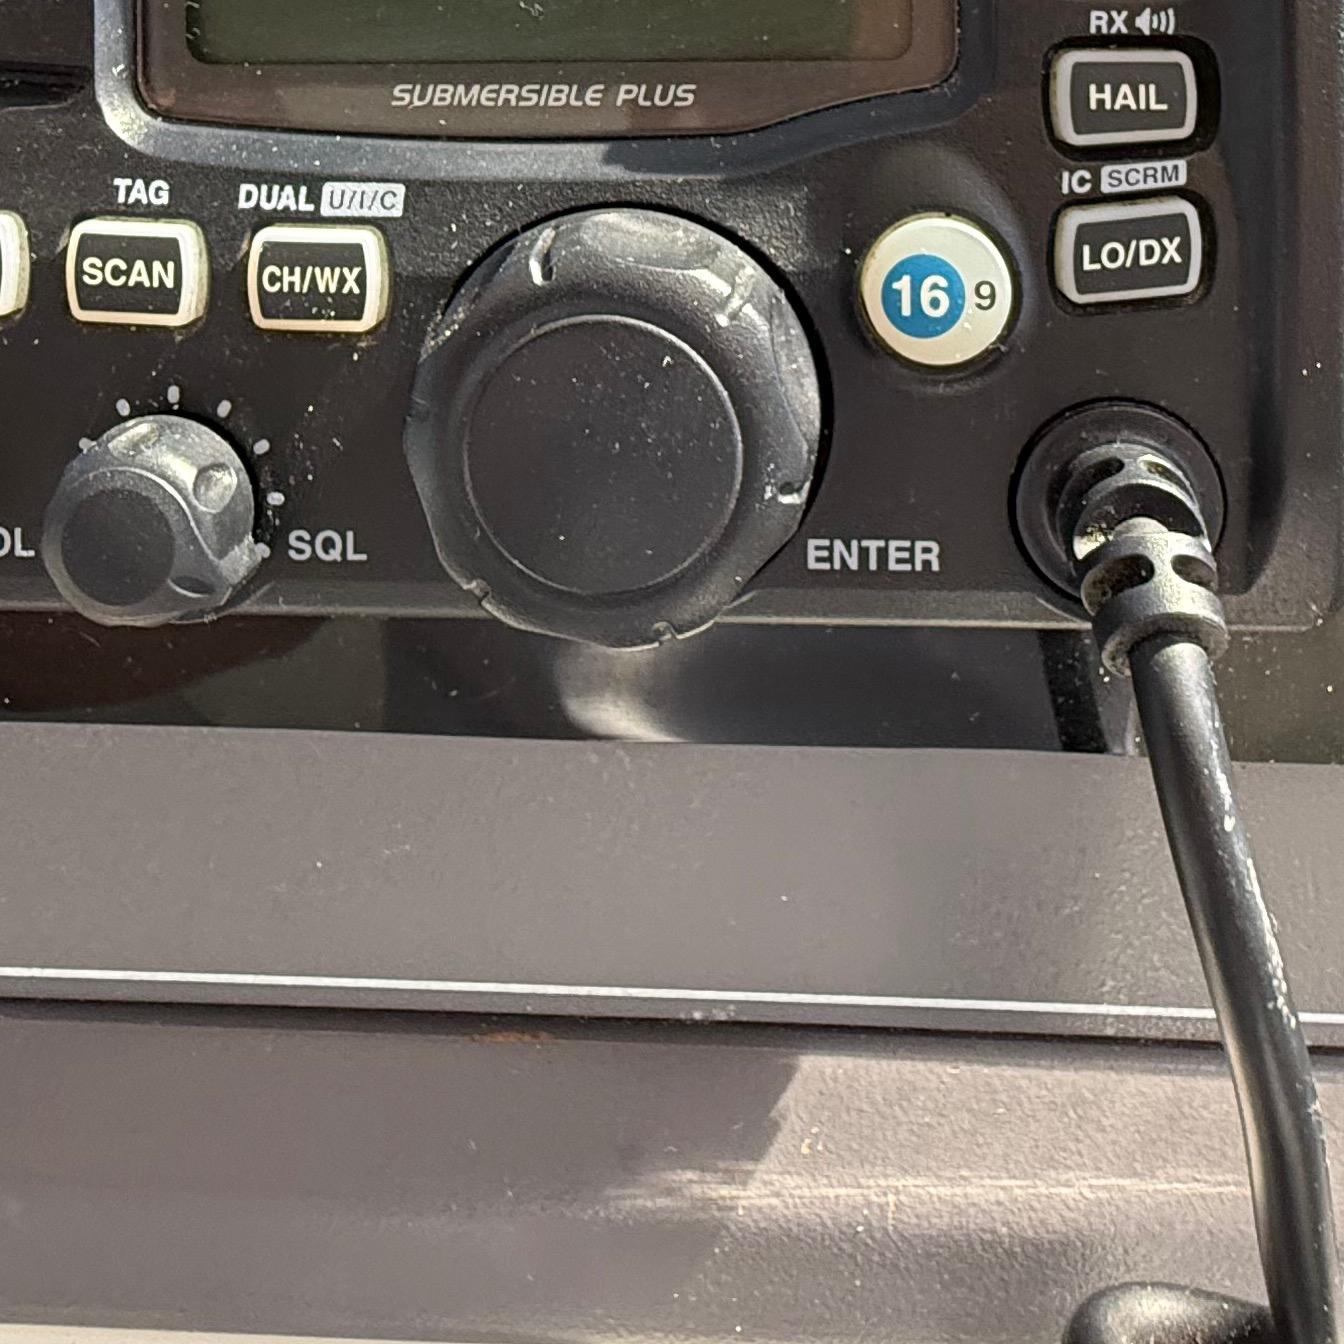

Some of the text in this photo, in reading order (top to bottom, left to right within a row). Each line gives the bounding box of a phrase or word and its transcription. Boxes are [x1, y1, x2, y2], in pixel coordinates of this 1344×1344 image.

[1088, 9, 1129, 34] RX
[391, 83, 698, 108] SUBMERSIBLE PLUS
[1087, 82, 1169, 112] HAIL
[113, 177, 171, 206] TAG
[1060, 164, 1181, 195] IC SCRM
[237, 183, 399, 212] DUAL U/I/C
[1081, 235, 1183, 272] LO/DX
[81, 258, 176, 289] SCAN
[261, 264, 363, 295] CH/WX
[890, 274, 997, 318] 16 9
[287, 529, 368, 562] SQL
[806, 538, 941, 572] ENTER
